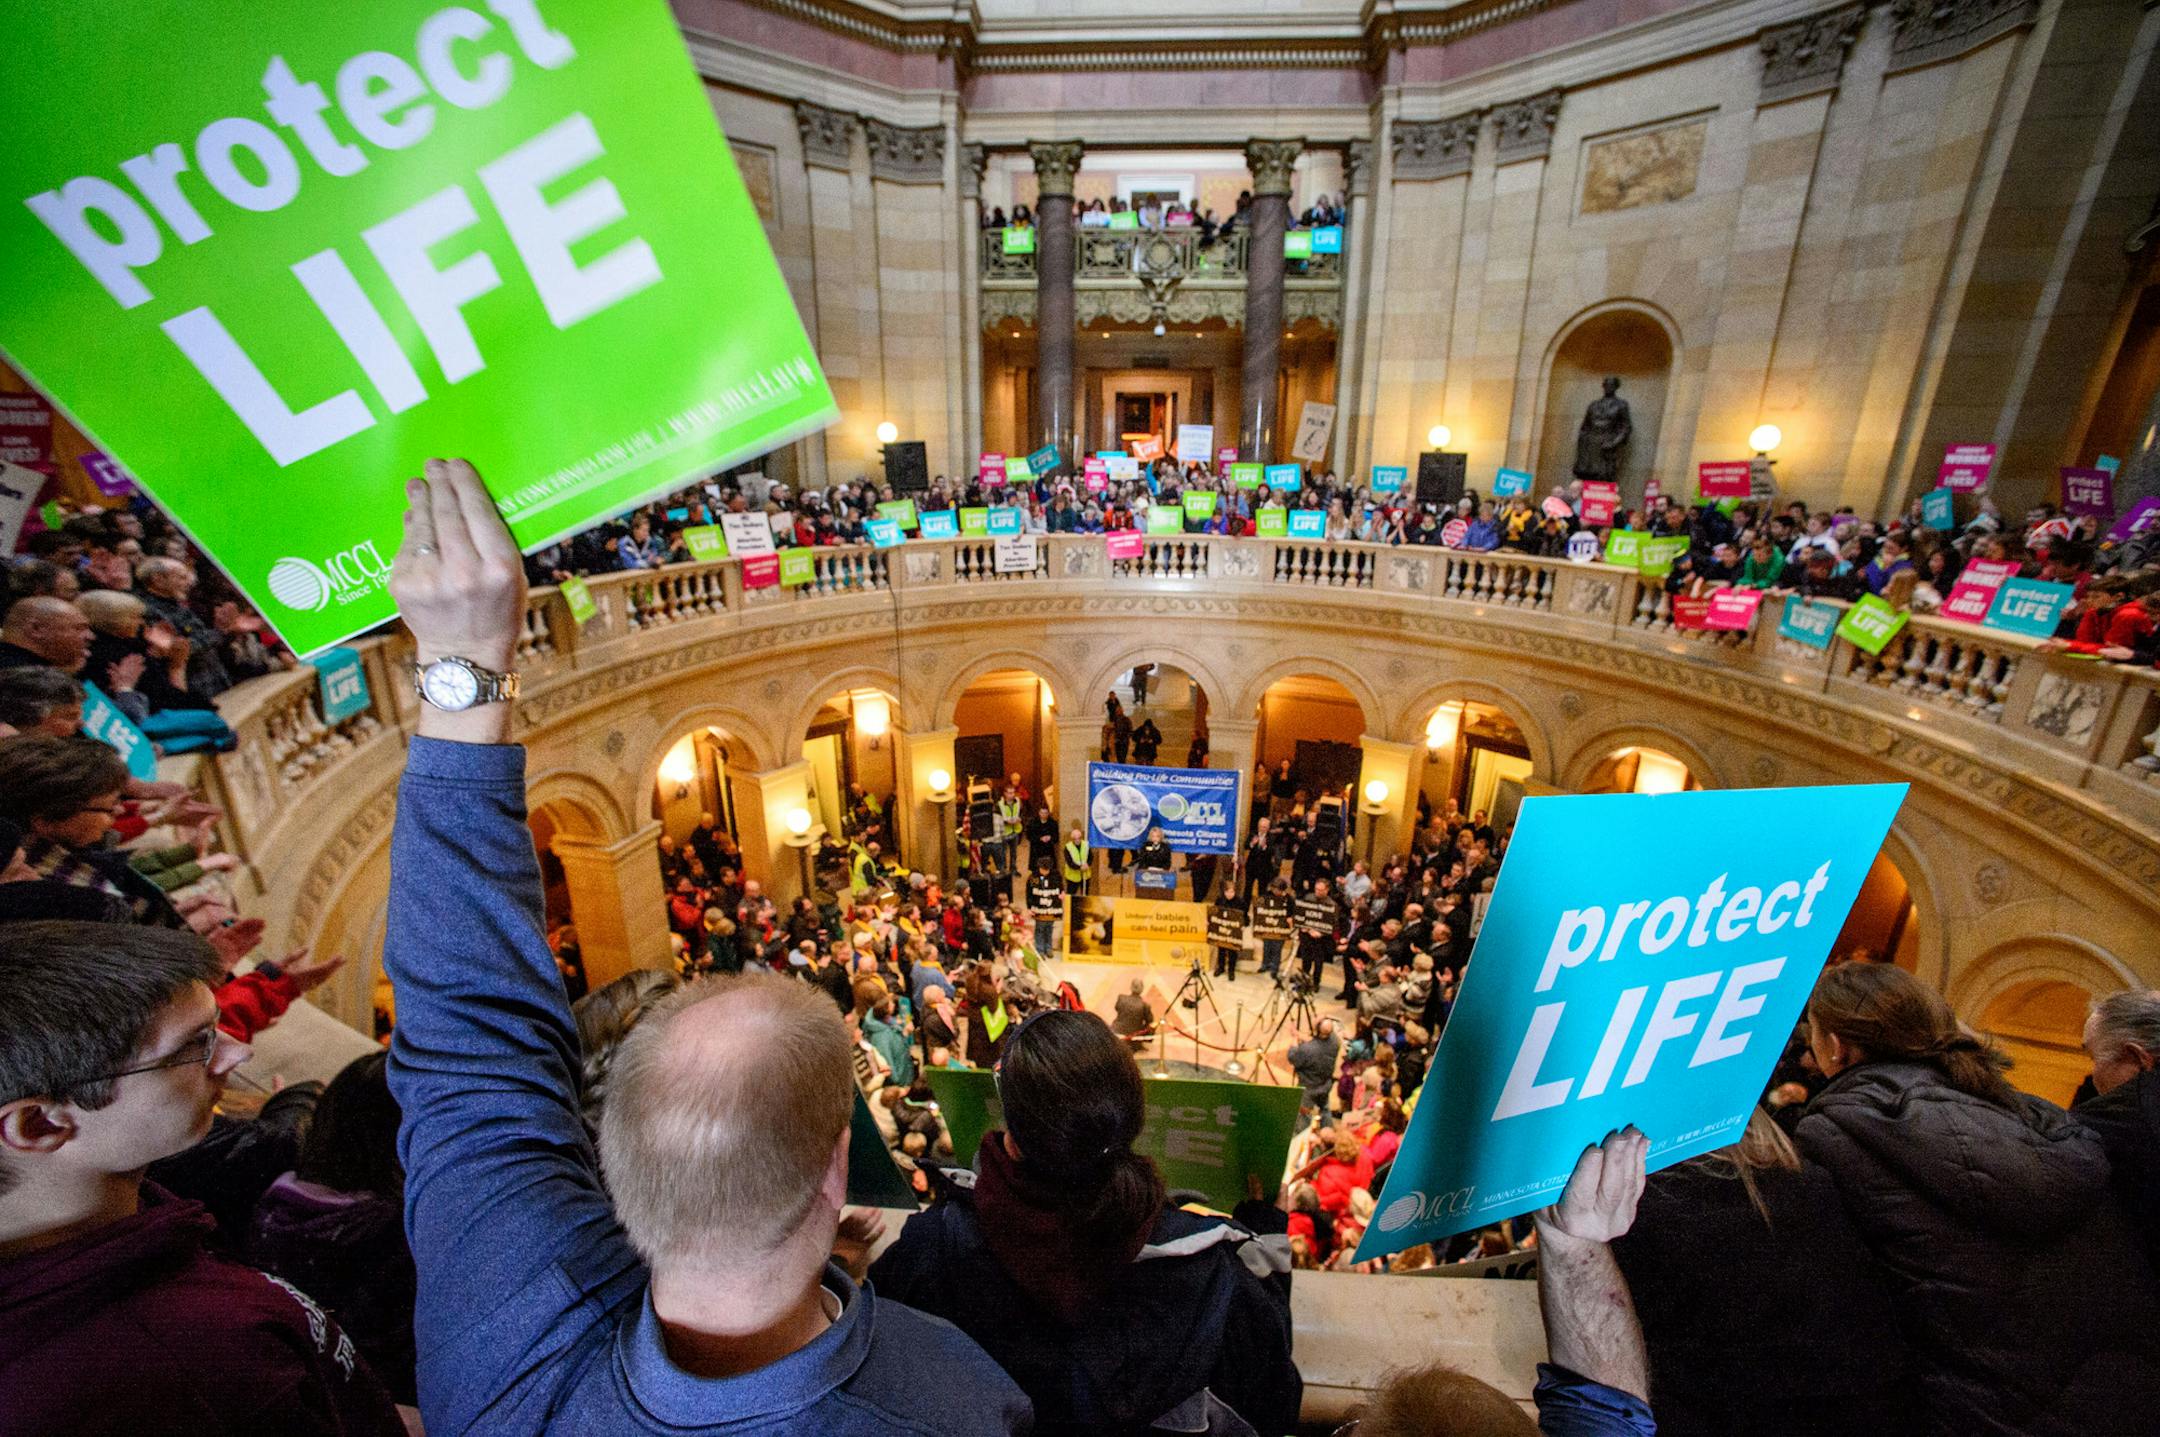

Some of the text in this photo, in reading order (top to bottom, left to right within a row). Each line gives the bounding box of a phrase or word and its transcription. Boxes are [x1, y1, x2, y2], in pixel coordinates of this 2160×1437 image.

[24, 0, 577, 310] protect
[160, 110, 665, 467] LIFE
[1235, 473, 1259, 483] LIFE
[1271, 473, 1296, 485] LIFE
[2067, 487, 2105, 506] LIFE
[1186, 500, 1211, 511] LIFE
[926, 520, 952, 531] LIFE
[991, 517, 1016, 528] LIFE
[1260, 518, 1283, 529] LIFE
[1293, 519, 1320, 531] LIFE
[1567, 541, 1599, 555] LIFE
[325, 539, 395, 592] MCCL
[335, 584, 373, 607] Since
[2000, 596, 2054, 622] LIFE
[1850, 610, 1891, 639] LIFE
[1092, 768, 1235, 786] Building Pro-Life Communities
[1196, 830, 1228, 839] Citizens
[1211, 839, 1228, 848] Life
[1156, 911, 1190, 922] babies
[1150, 924, 1168, 933] feel
[1169, 923, 1199, 936] pain
[1534, 858, 1832, 993] protect
[1491, 956, 1788, 1122] LIFE
[1677, 1114, 1744, 1142] www.mccl.org
[1484, 1180, 1540, 1204] MINNESOTA
